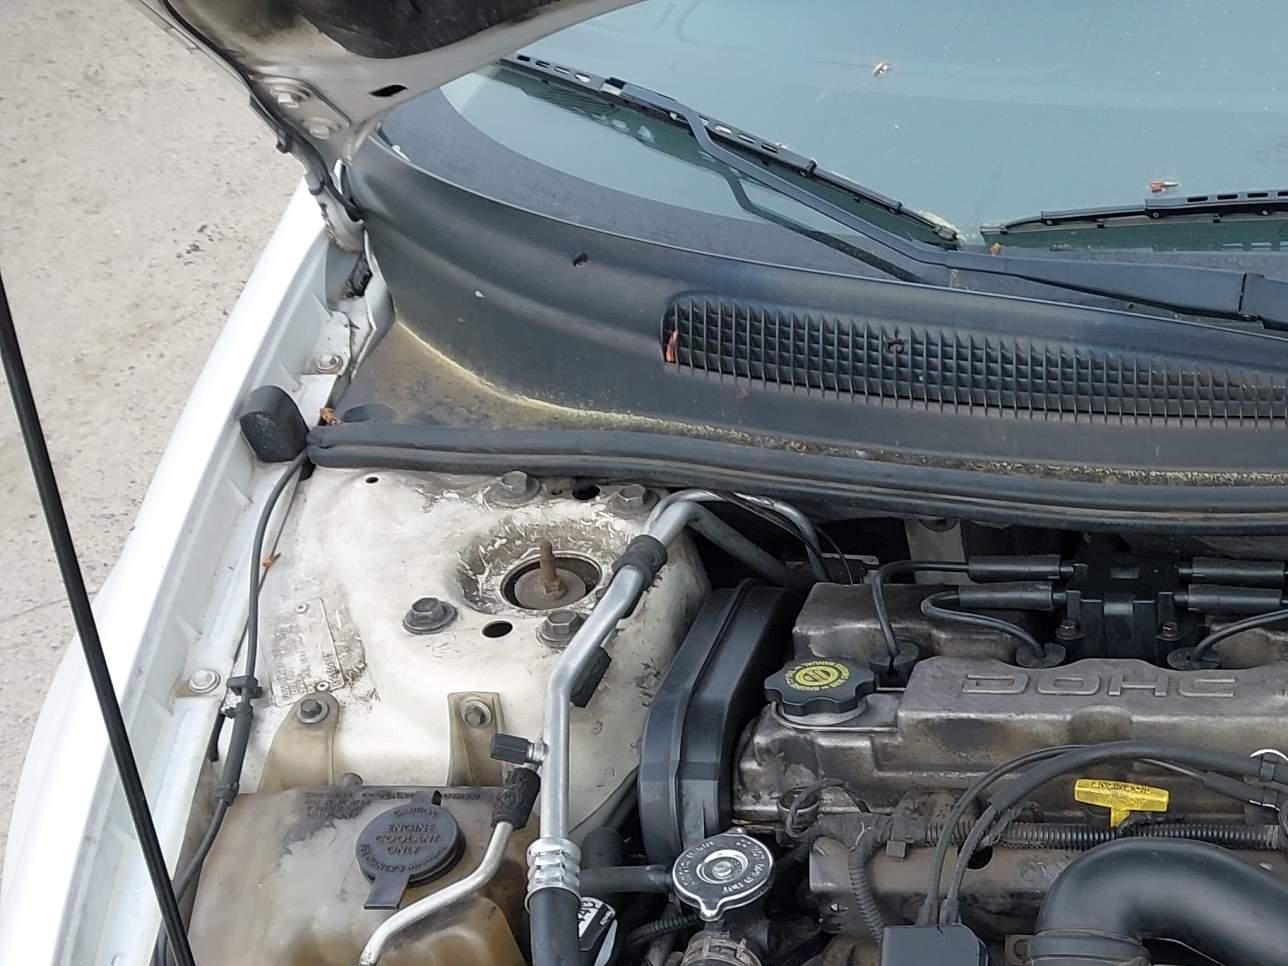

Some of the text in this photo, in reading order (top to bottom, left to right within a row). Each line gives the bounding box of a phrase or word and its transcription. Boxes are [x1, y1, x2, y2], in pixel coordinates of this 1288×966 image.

[962, 672, 1236, 698] DOHC
[387, 823, 437, 833] ENGINE
[376, 834, 440, 843] COOLANT
[385, 845, 420, 855] ONLY
